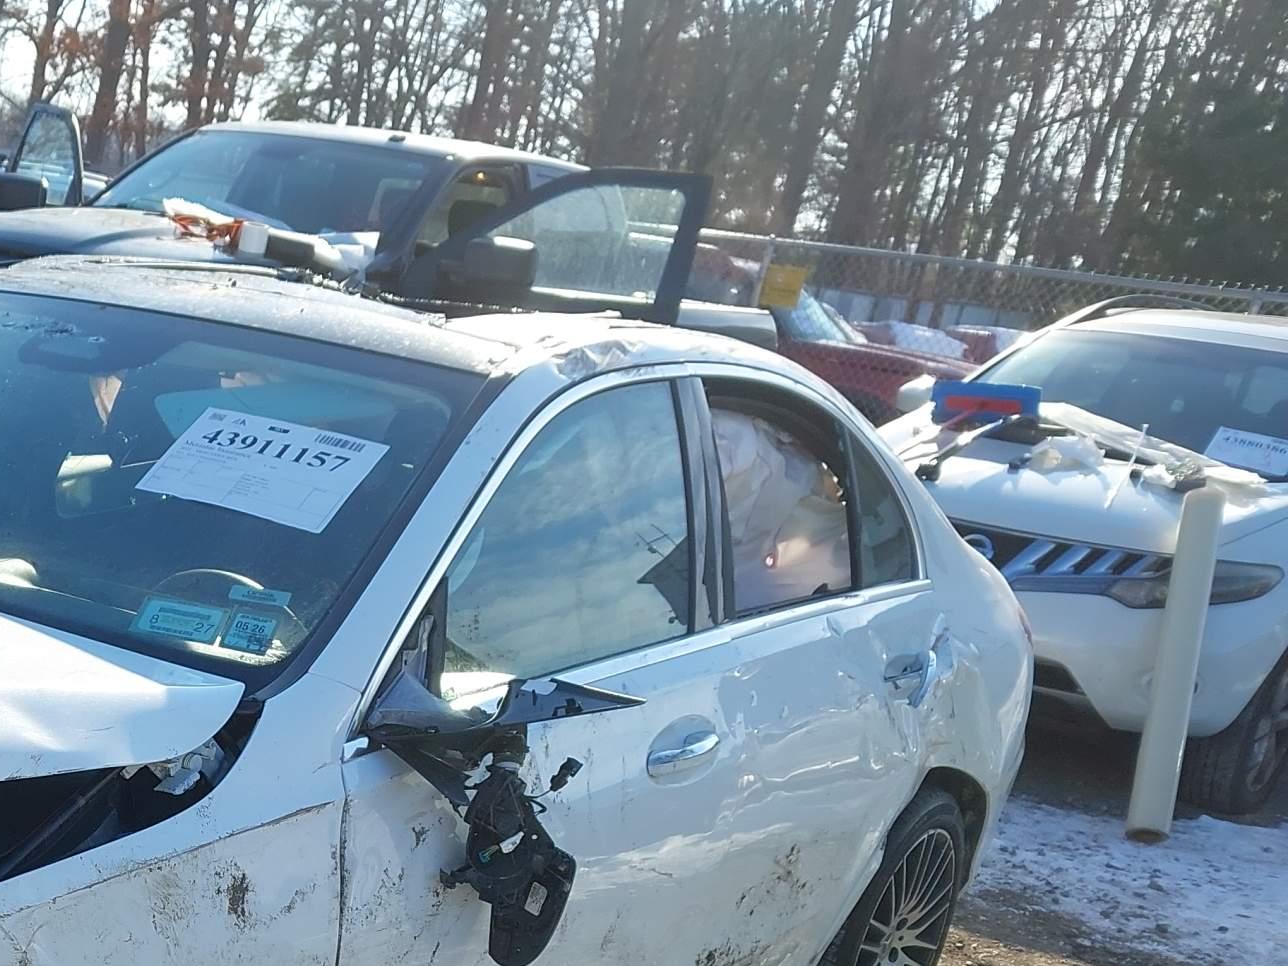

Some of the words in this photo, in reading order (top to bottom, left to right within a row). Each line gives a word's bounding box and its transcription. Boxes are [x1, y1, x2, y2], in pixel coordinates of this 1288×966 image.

[201, 428, 351, 472] 43911157
[149, 614, 160, 624] 8
[194, 622, 216, 634] 27
[235, 620, 249, 631] 05
[251, 624, 266, 634] 26
